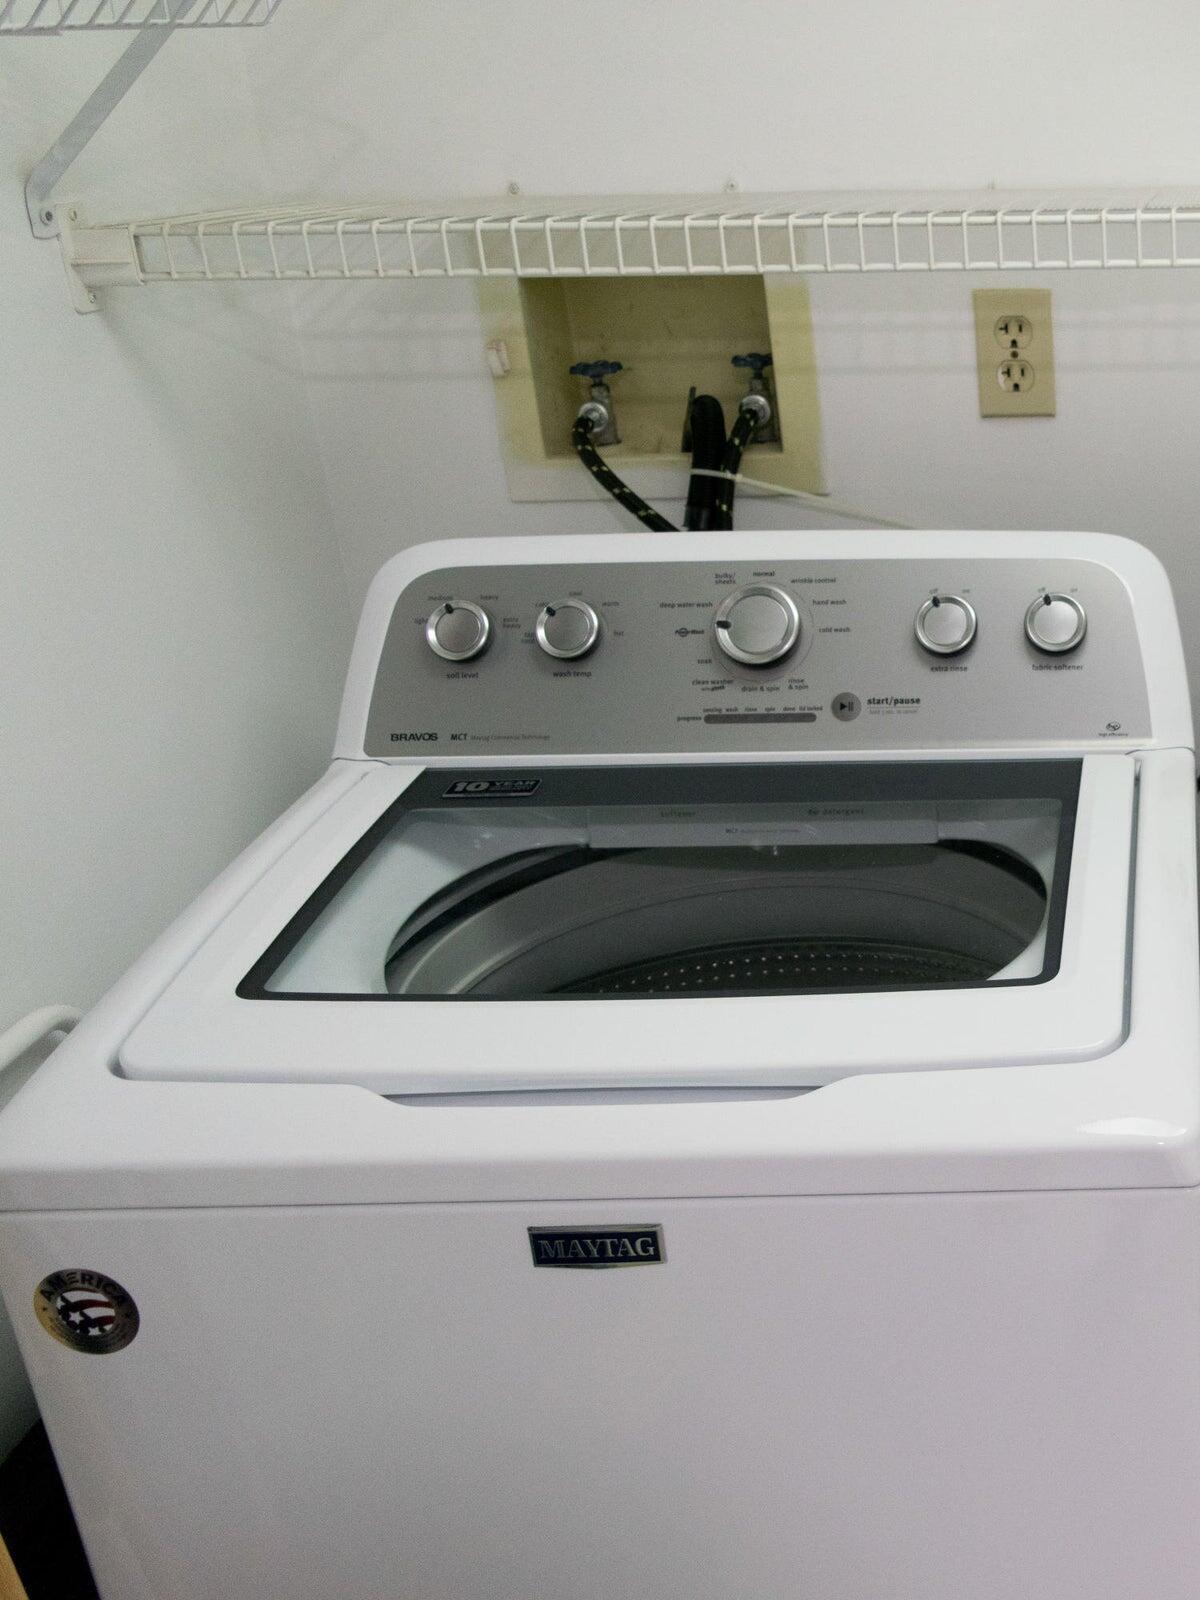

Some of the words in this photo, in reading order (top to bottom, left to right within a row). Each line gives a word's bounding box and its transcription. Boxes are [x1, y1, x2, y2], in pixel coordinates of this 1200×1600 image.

[930, 665, 949, 673] extra
[950, 665, 968, 673] rinse
[1031, 663, 1053, 671] fabric
[1053, 663, 1083, 671] softener
[446, 671, 460, 679] soil
[460, 671, 479, 679] level
[552, 670, 572, 678] wash
[573, 670, 592, 680] temp
[866, 696, 921, 707] start/pause
[389, 732, 439, 742] BRAVOS
[449, 732, 469, 742] MCT
[453, 781, 491, 792] 10
[537, 1236, 656, 1259] MAYTAG
[39, 1270, 127, 1308] AMERICA
